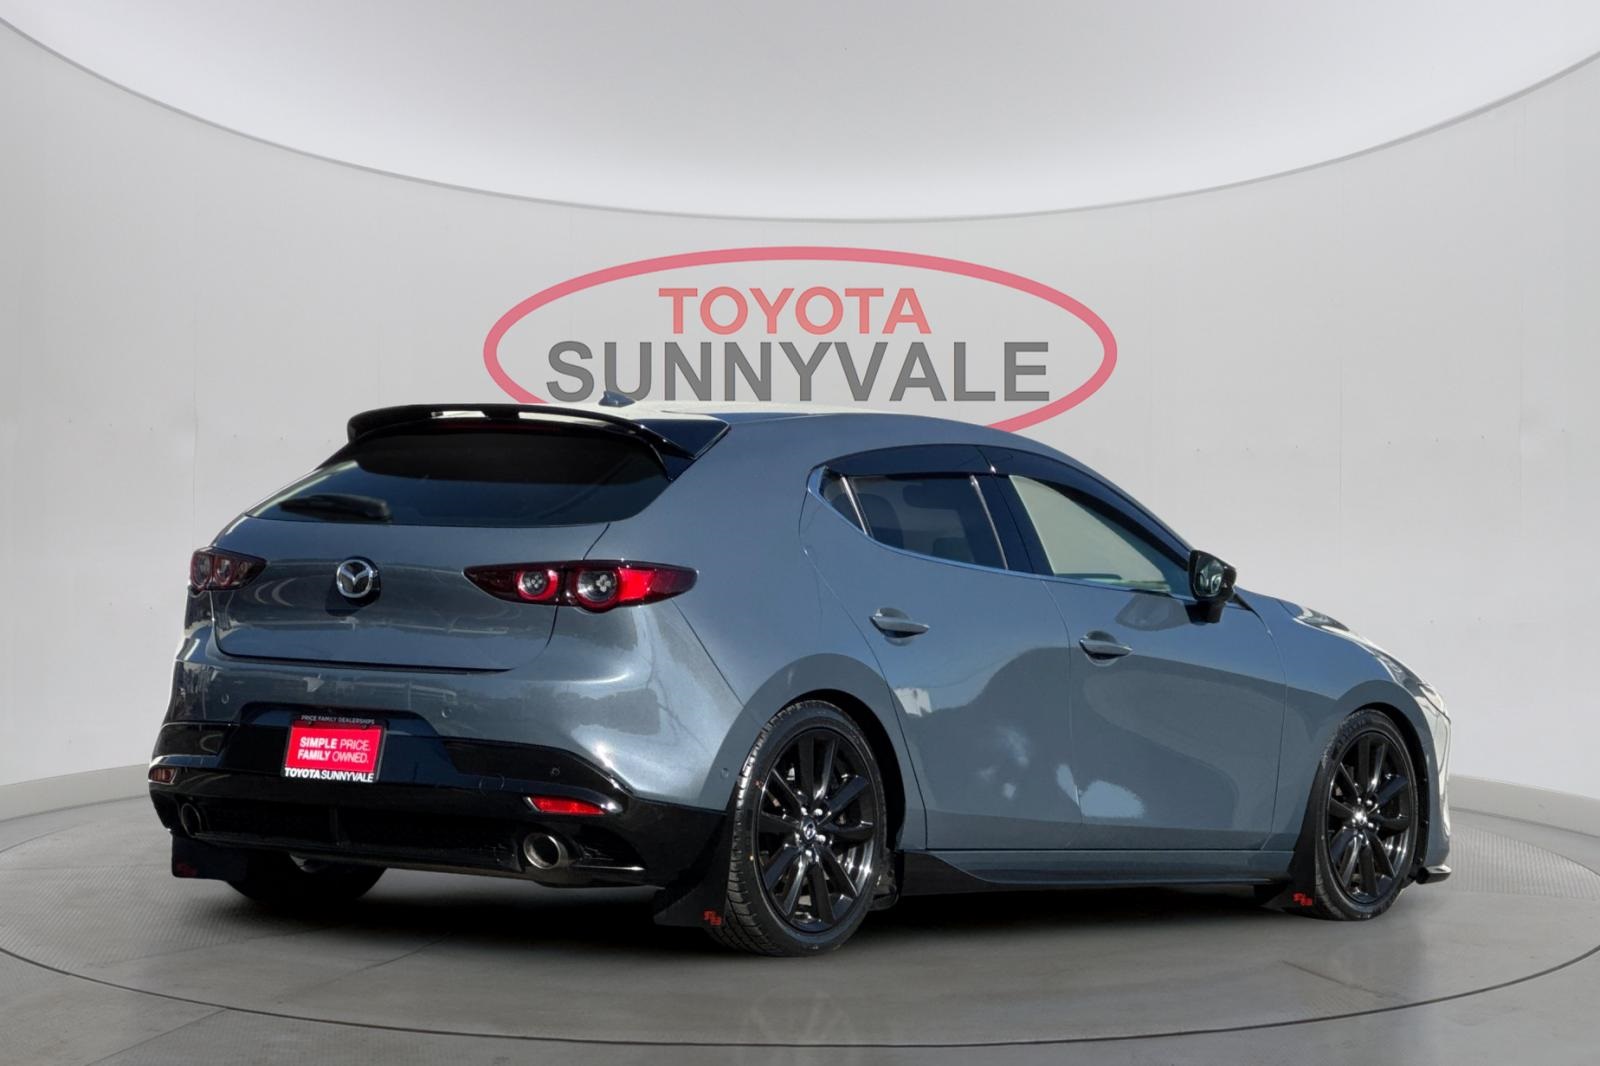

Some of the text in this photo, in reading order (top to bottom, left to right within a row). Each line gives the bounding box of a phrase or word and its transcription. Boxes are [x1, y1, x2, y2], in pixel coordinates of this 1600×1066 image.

[658, 286, 932, 335] TOYOTA
[546, 340, 1050, 402] SUNNYVALE
[297, 749, 369, 764] FAMILY OWNED.
[299, 736, 338, 749] SIMPLE
